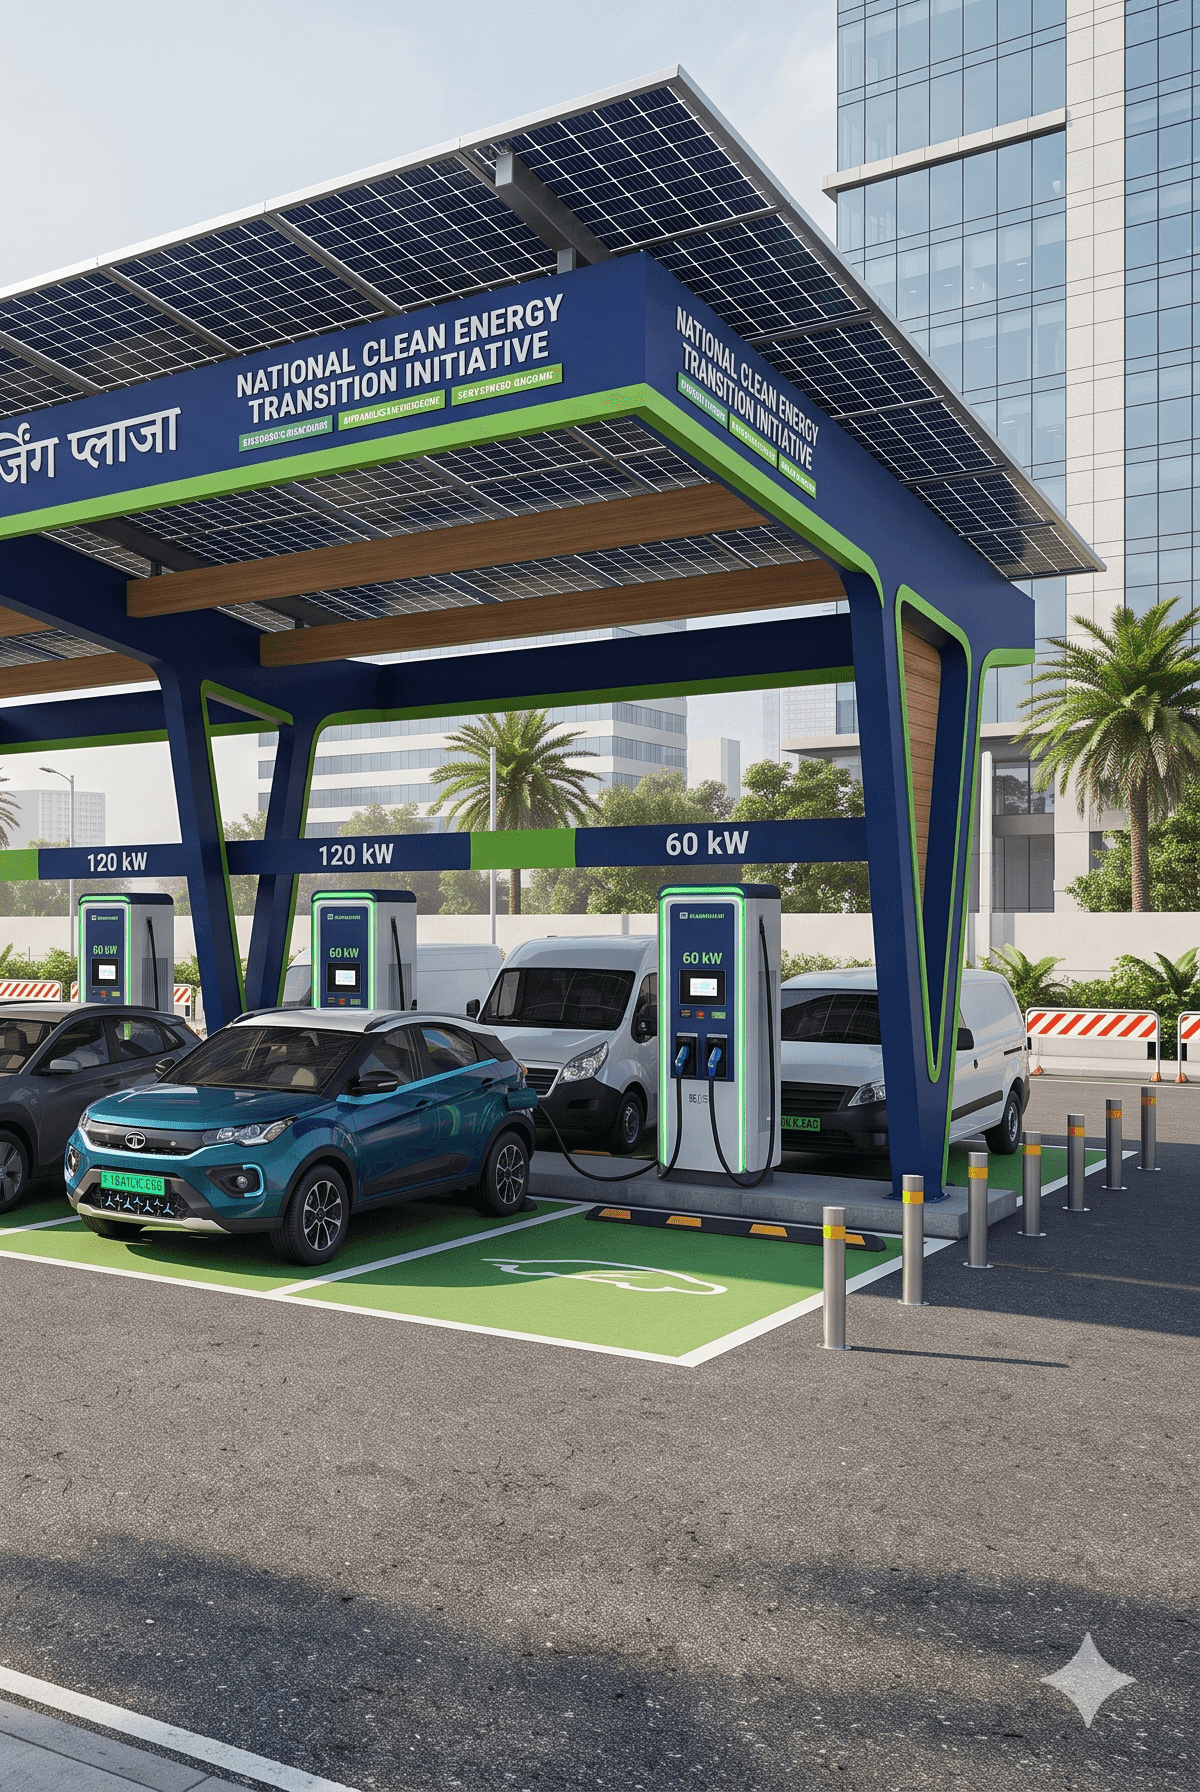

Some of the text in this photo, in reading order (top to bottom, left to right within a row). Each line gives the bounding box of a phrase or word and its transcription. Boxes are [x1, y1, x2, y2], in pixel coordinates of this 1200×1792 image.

[236, 293, 564, 398] NATIONAL CLEAN ENERGY
[248, 366, 398, 424] TRANSITION
[405, 330, 550, 389] INITIATIVE
[676, 305, 738, 381] NATIONAL
[740, 362, 777, 413] CLEAN
[778, 394, 819, 447] ENERGY
[682, 341, 754, 424] TRANSITION
[756, 404, 813, 471] INITIATIVE
[67, 407, 182, 469] प्लाजा
[87, 851, 148, 872] 120 kW
[319, 842, 394, 866] 120 kW
[666, 829, 750, 856] 60 kW
[329, 947, 359, 958] 60 kW
[682, 951, 723, 965] 60 kW
